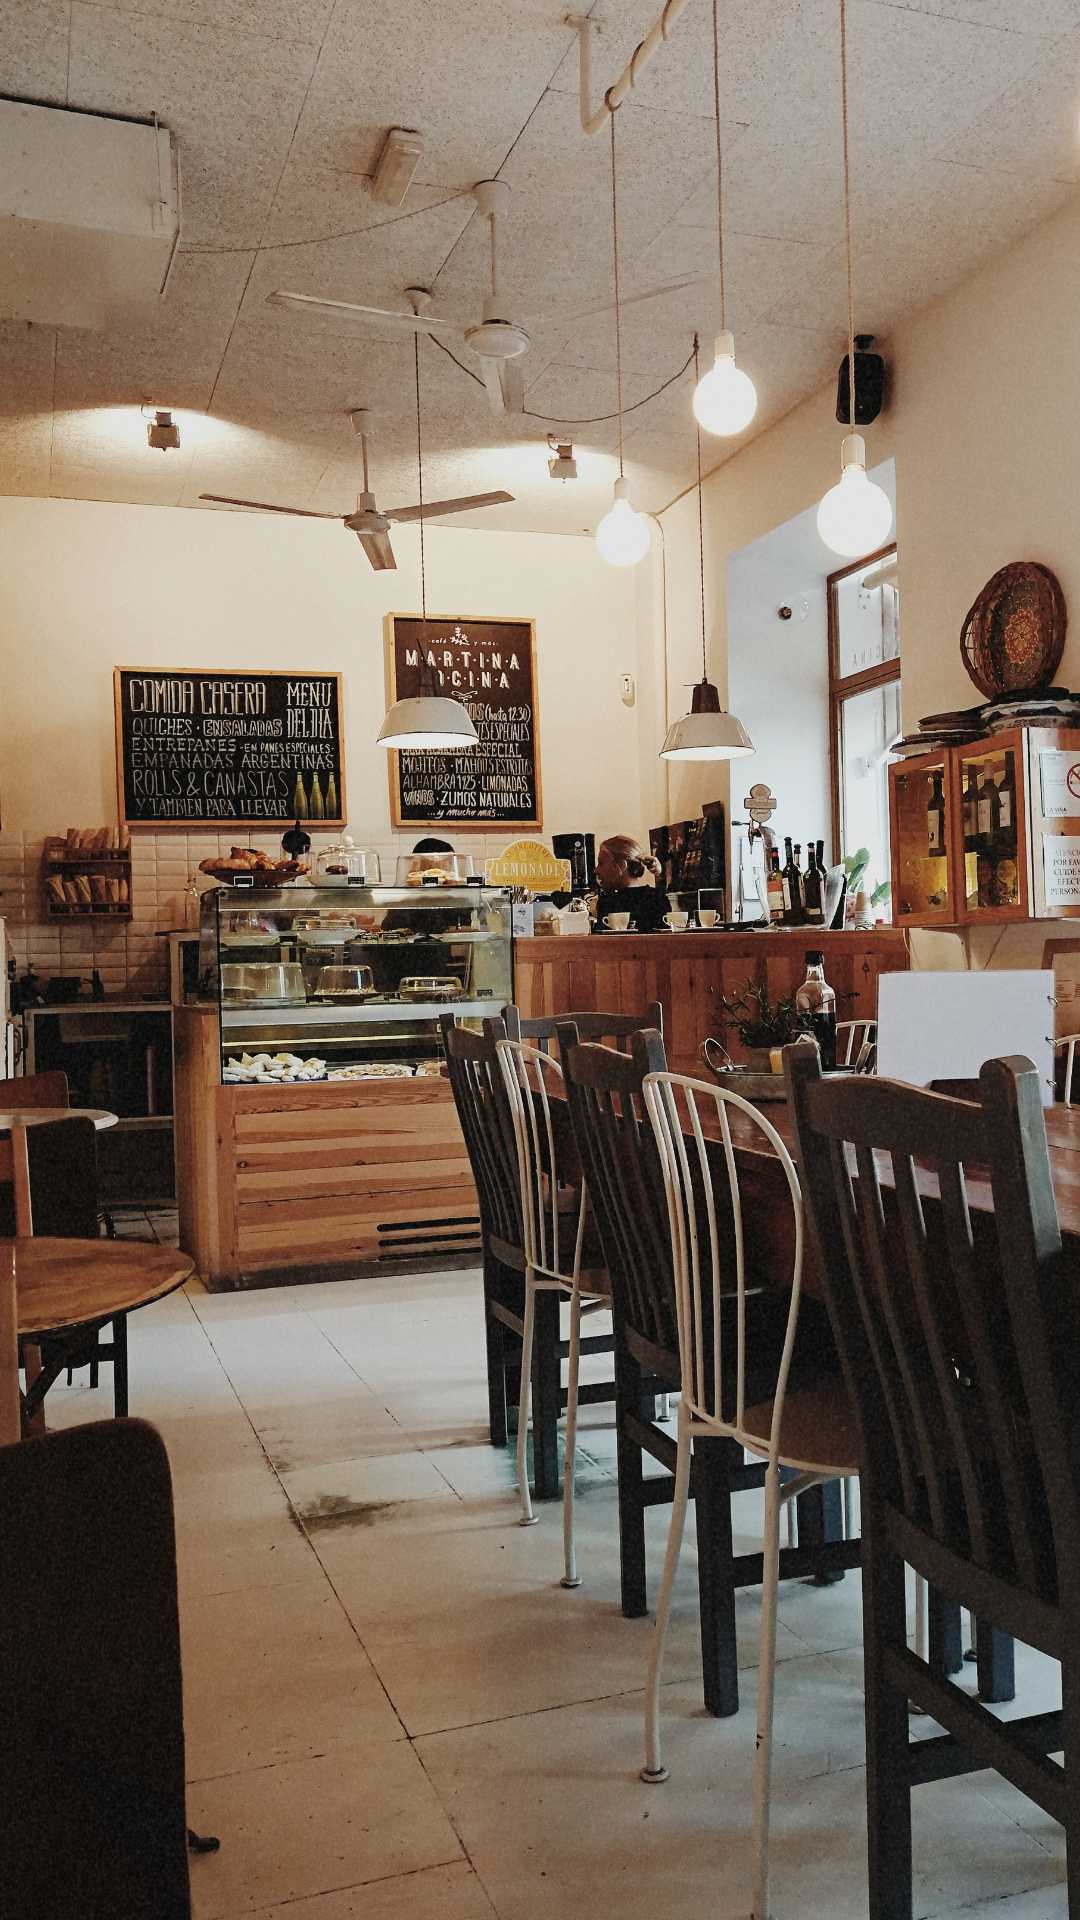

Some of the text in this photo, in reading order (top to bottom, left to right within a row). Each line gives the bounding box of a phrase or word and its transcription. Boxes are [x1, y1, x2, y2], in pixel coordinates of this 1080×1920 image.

[129, 679, 266, 715] COMIDA CASERA
[132, 717, 283, 737] QUICHES ENSALADAS
[286, 707, 310, 738] DEL
[131, 737, 237, 752] ENTREPANES
[260, 742, 285, 754] PANES
[475, 743, 522, 758] ESPECIAL
[131, 752, 335, 770] EMPANADAS ARGENTINAS
[402, 757, 446, 774] MOJITOS
[132, 769, 289, 797] ROLLS & CANASTAS
[402, 773, 528, 792] ALHAMBRA 1925 LIMONADAS
[206, 798, 237, 817] PARA
[240, 799, 288, 817] LLEVAR
[440, 790, 477, 807] ZUMOS
[479, 792, 532, 808] NATURALES
[445, 807, 476, 818] mucho
